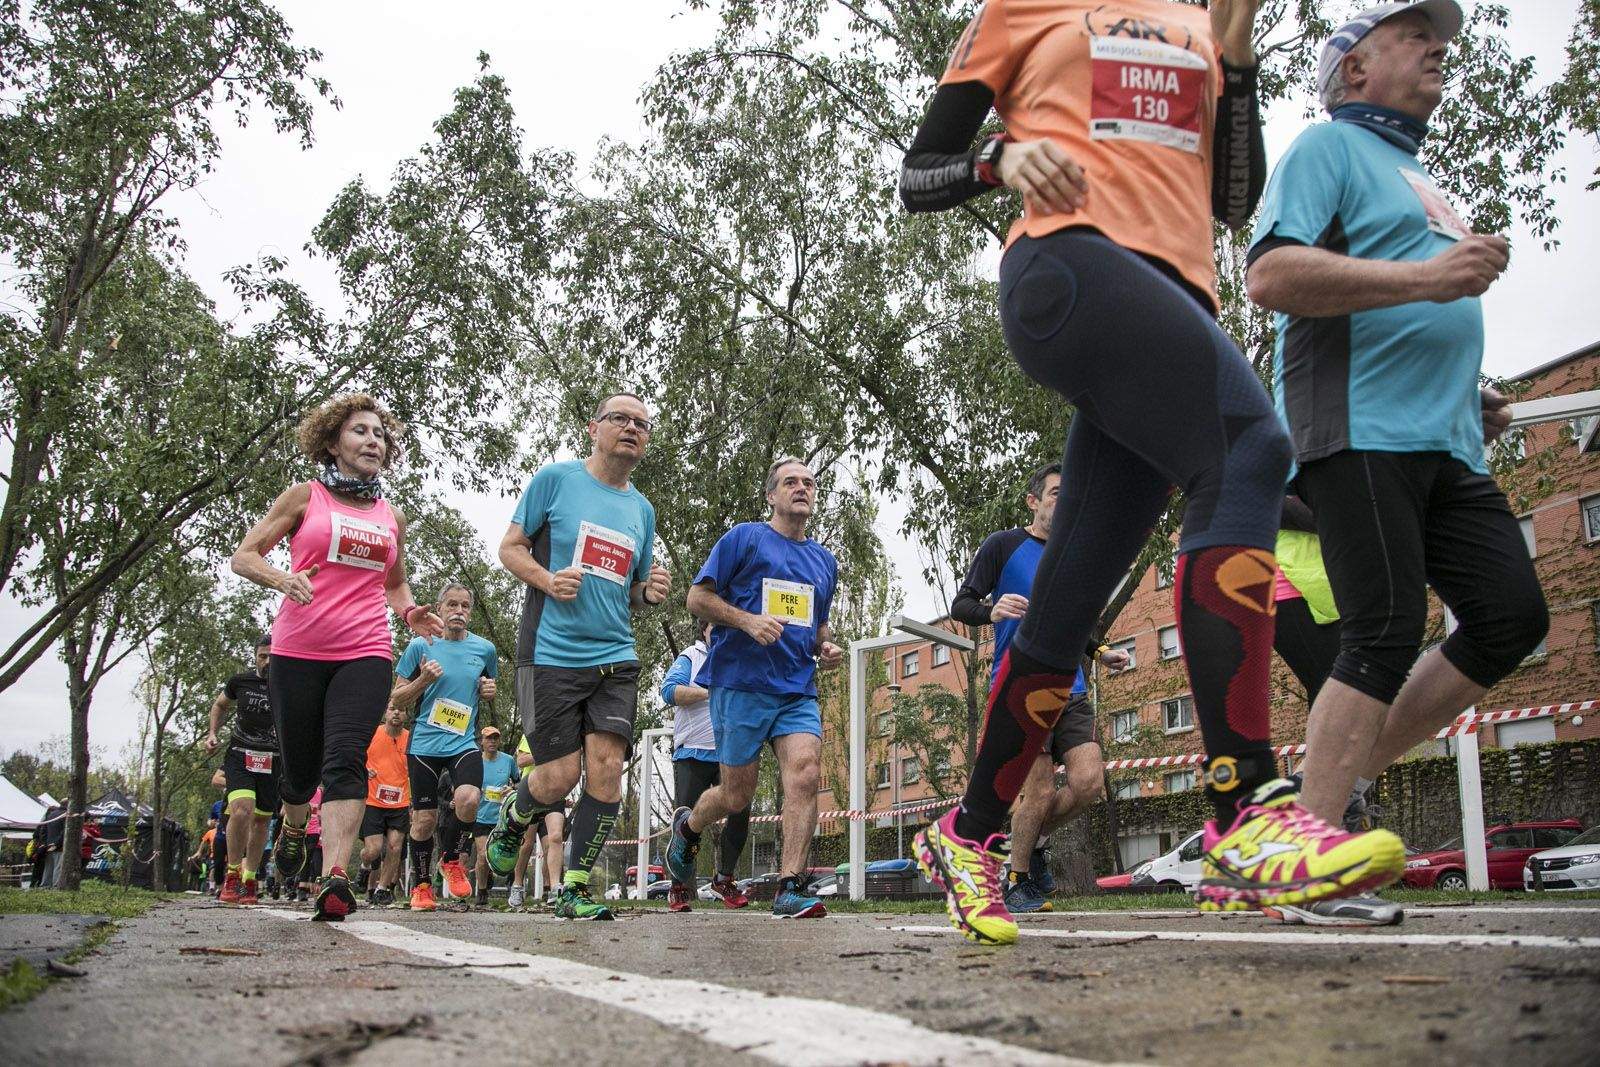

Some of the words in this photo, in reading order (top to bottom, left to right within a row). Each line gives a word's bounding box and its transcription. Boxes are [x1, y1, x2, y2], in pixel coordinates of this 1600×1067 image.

[1121, 66, 1180, 95] IRMA
[1131, 94, 1170, 122] 130
[341, 527, 383, 546] AMALIA
[349, 543, 371, 558] 200
[600, 556, 617, 571] 122
[780, 594, 799, 605] PERE
[785, 606, 795, 616] 16
[441, 707, 466, 720] ALBERT
[446, 718, 456, 726] 47
